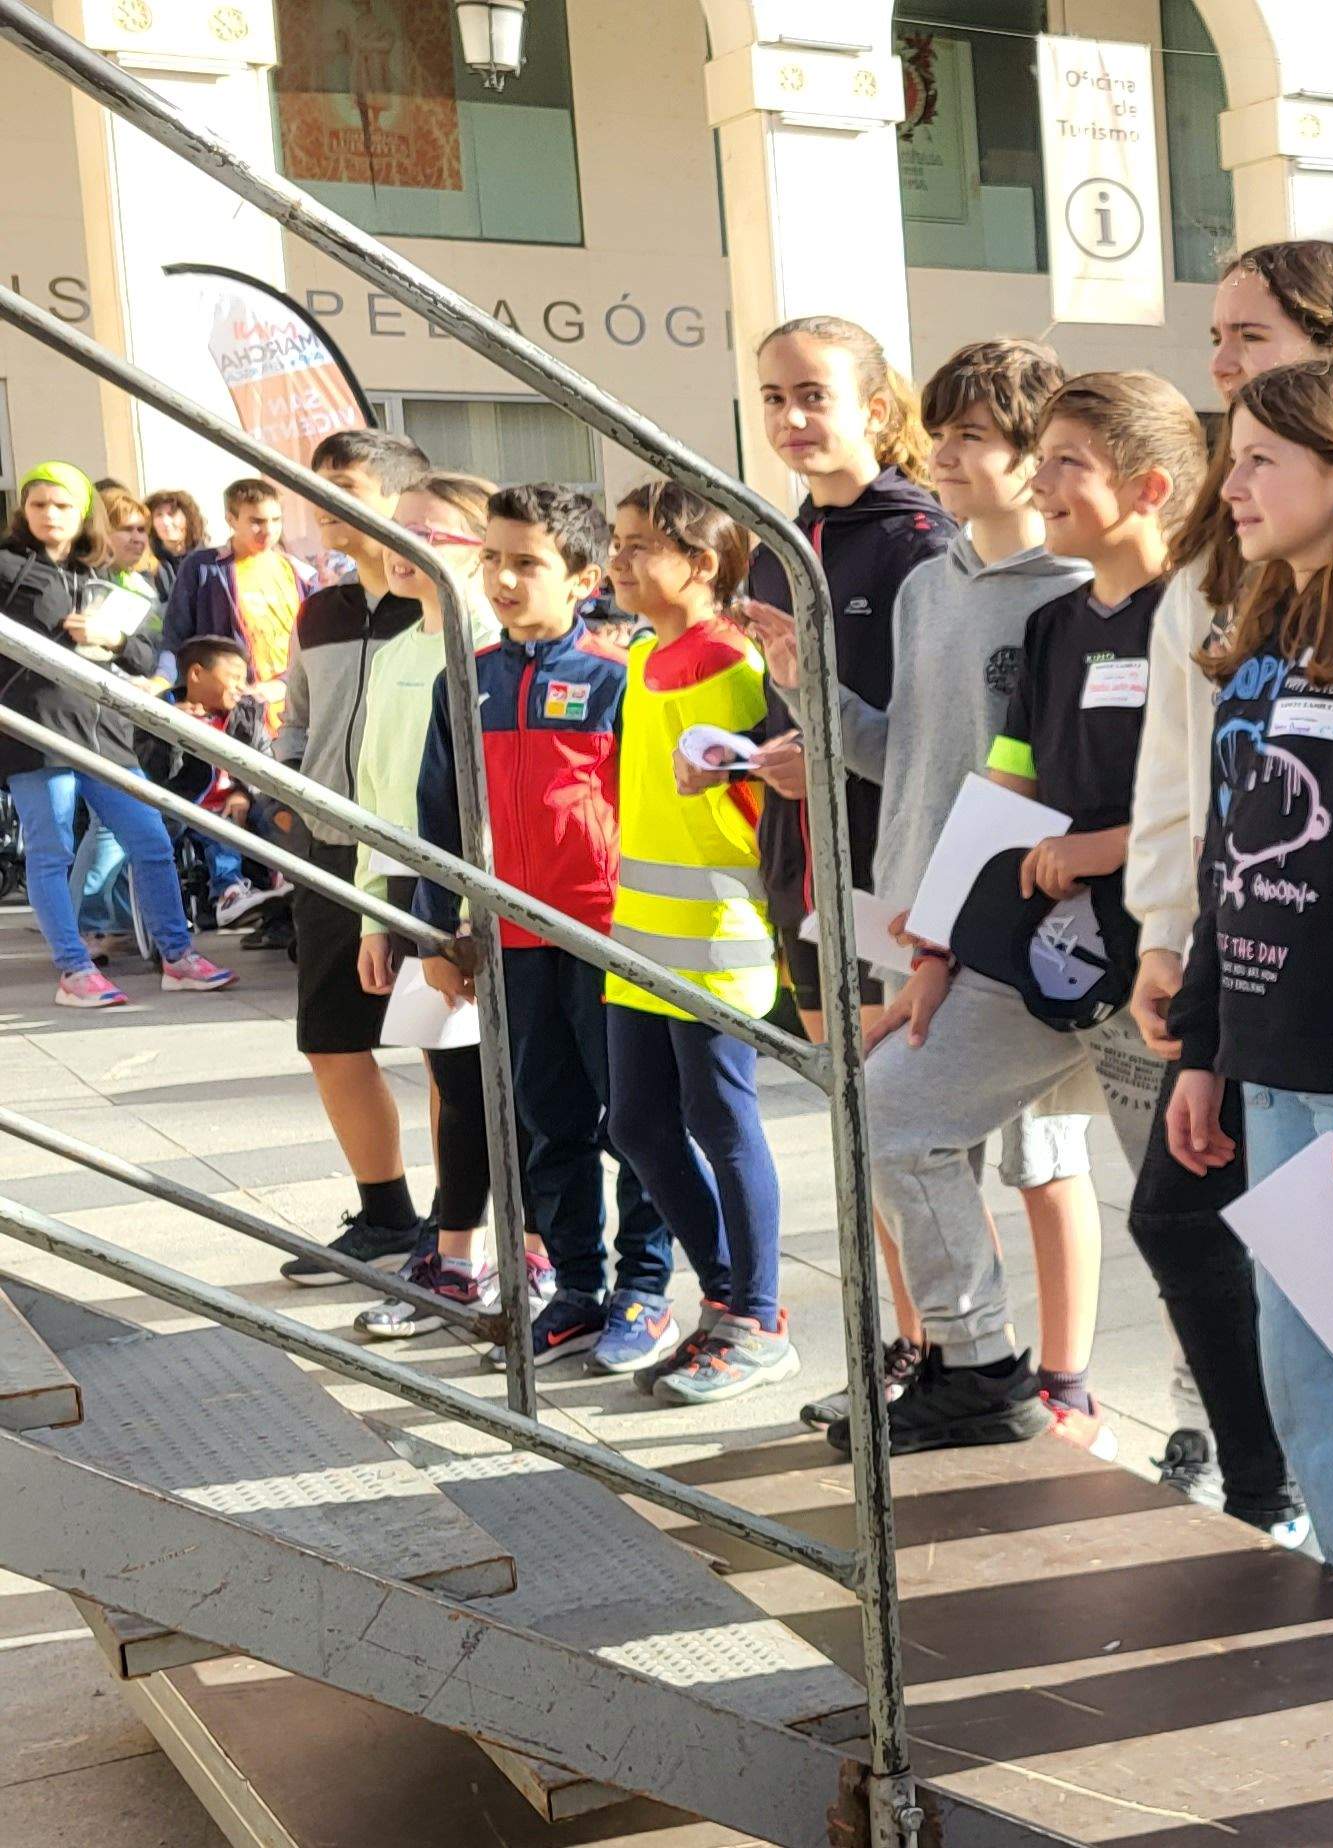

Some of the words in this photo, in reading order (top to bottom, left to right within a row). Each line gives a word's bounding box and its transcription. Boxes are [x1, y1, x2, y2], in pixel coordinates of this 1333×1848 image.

[305, 288, 735, 352] PEAGÓGI
[1232, 937, 1255, 960] THE
[1258, 941, 1289, 970] DAY
